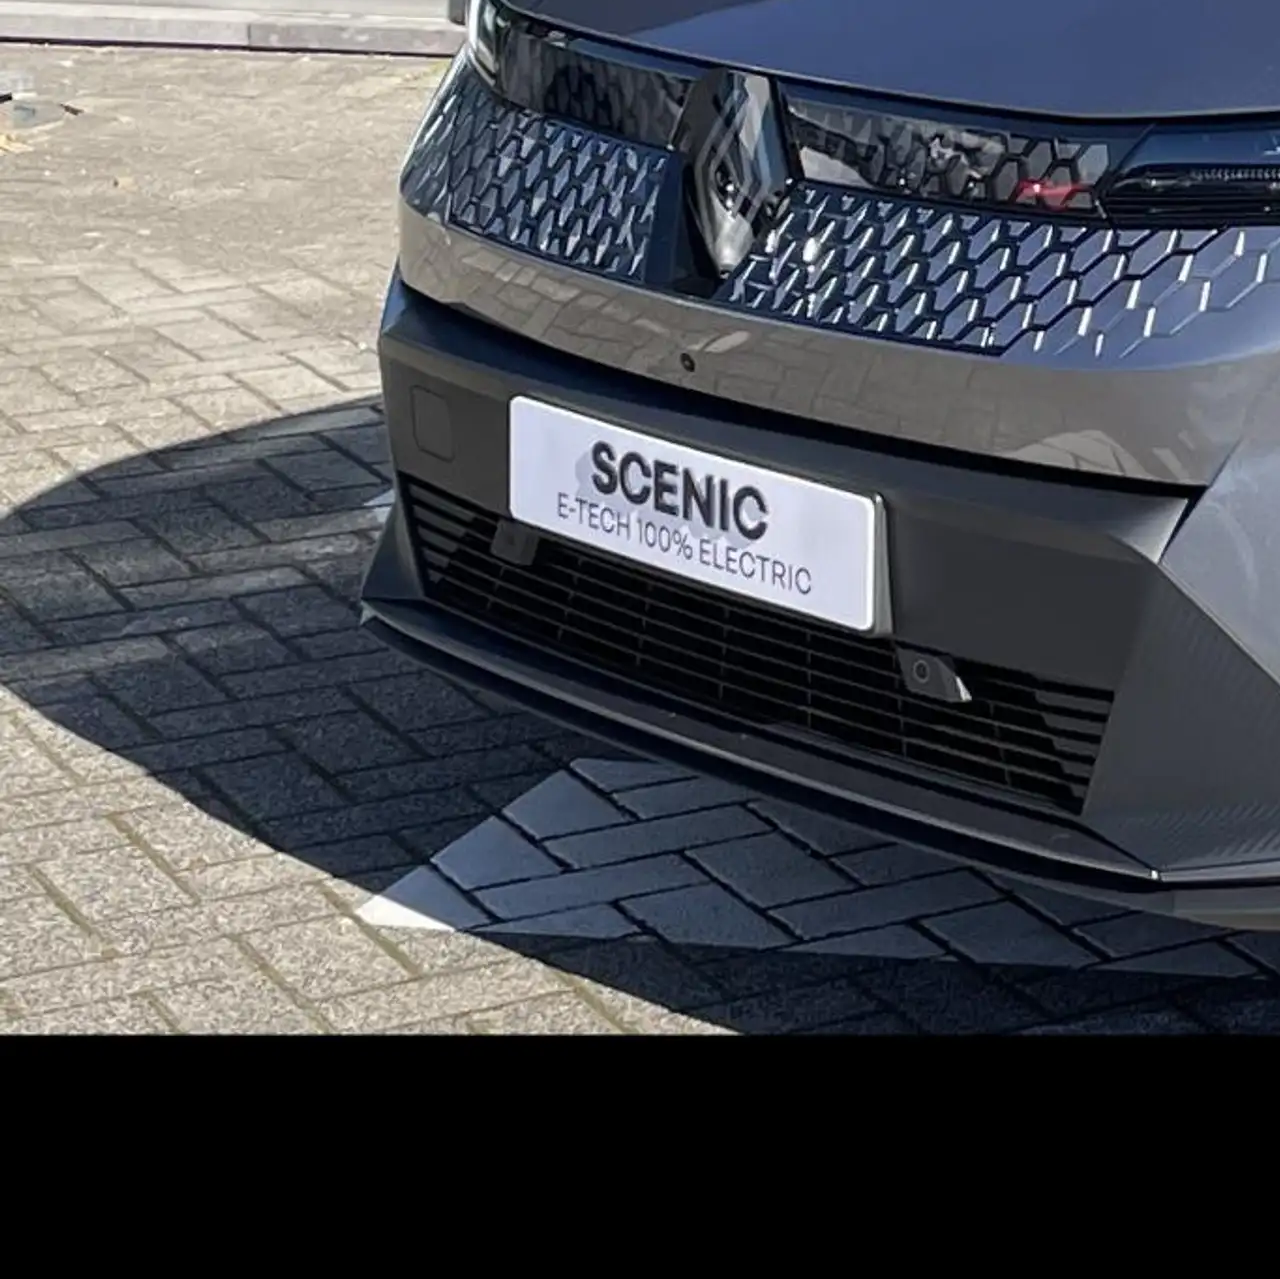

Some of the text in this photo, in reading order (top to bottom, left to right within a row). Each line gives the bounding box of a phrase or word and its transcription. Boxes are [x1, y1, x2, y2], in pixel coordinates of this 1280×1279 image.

[591, 441, 768, 541] SCENIC
[557, 492, 812, 596] E-TECH 100% ELECTRIC
